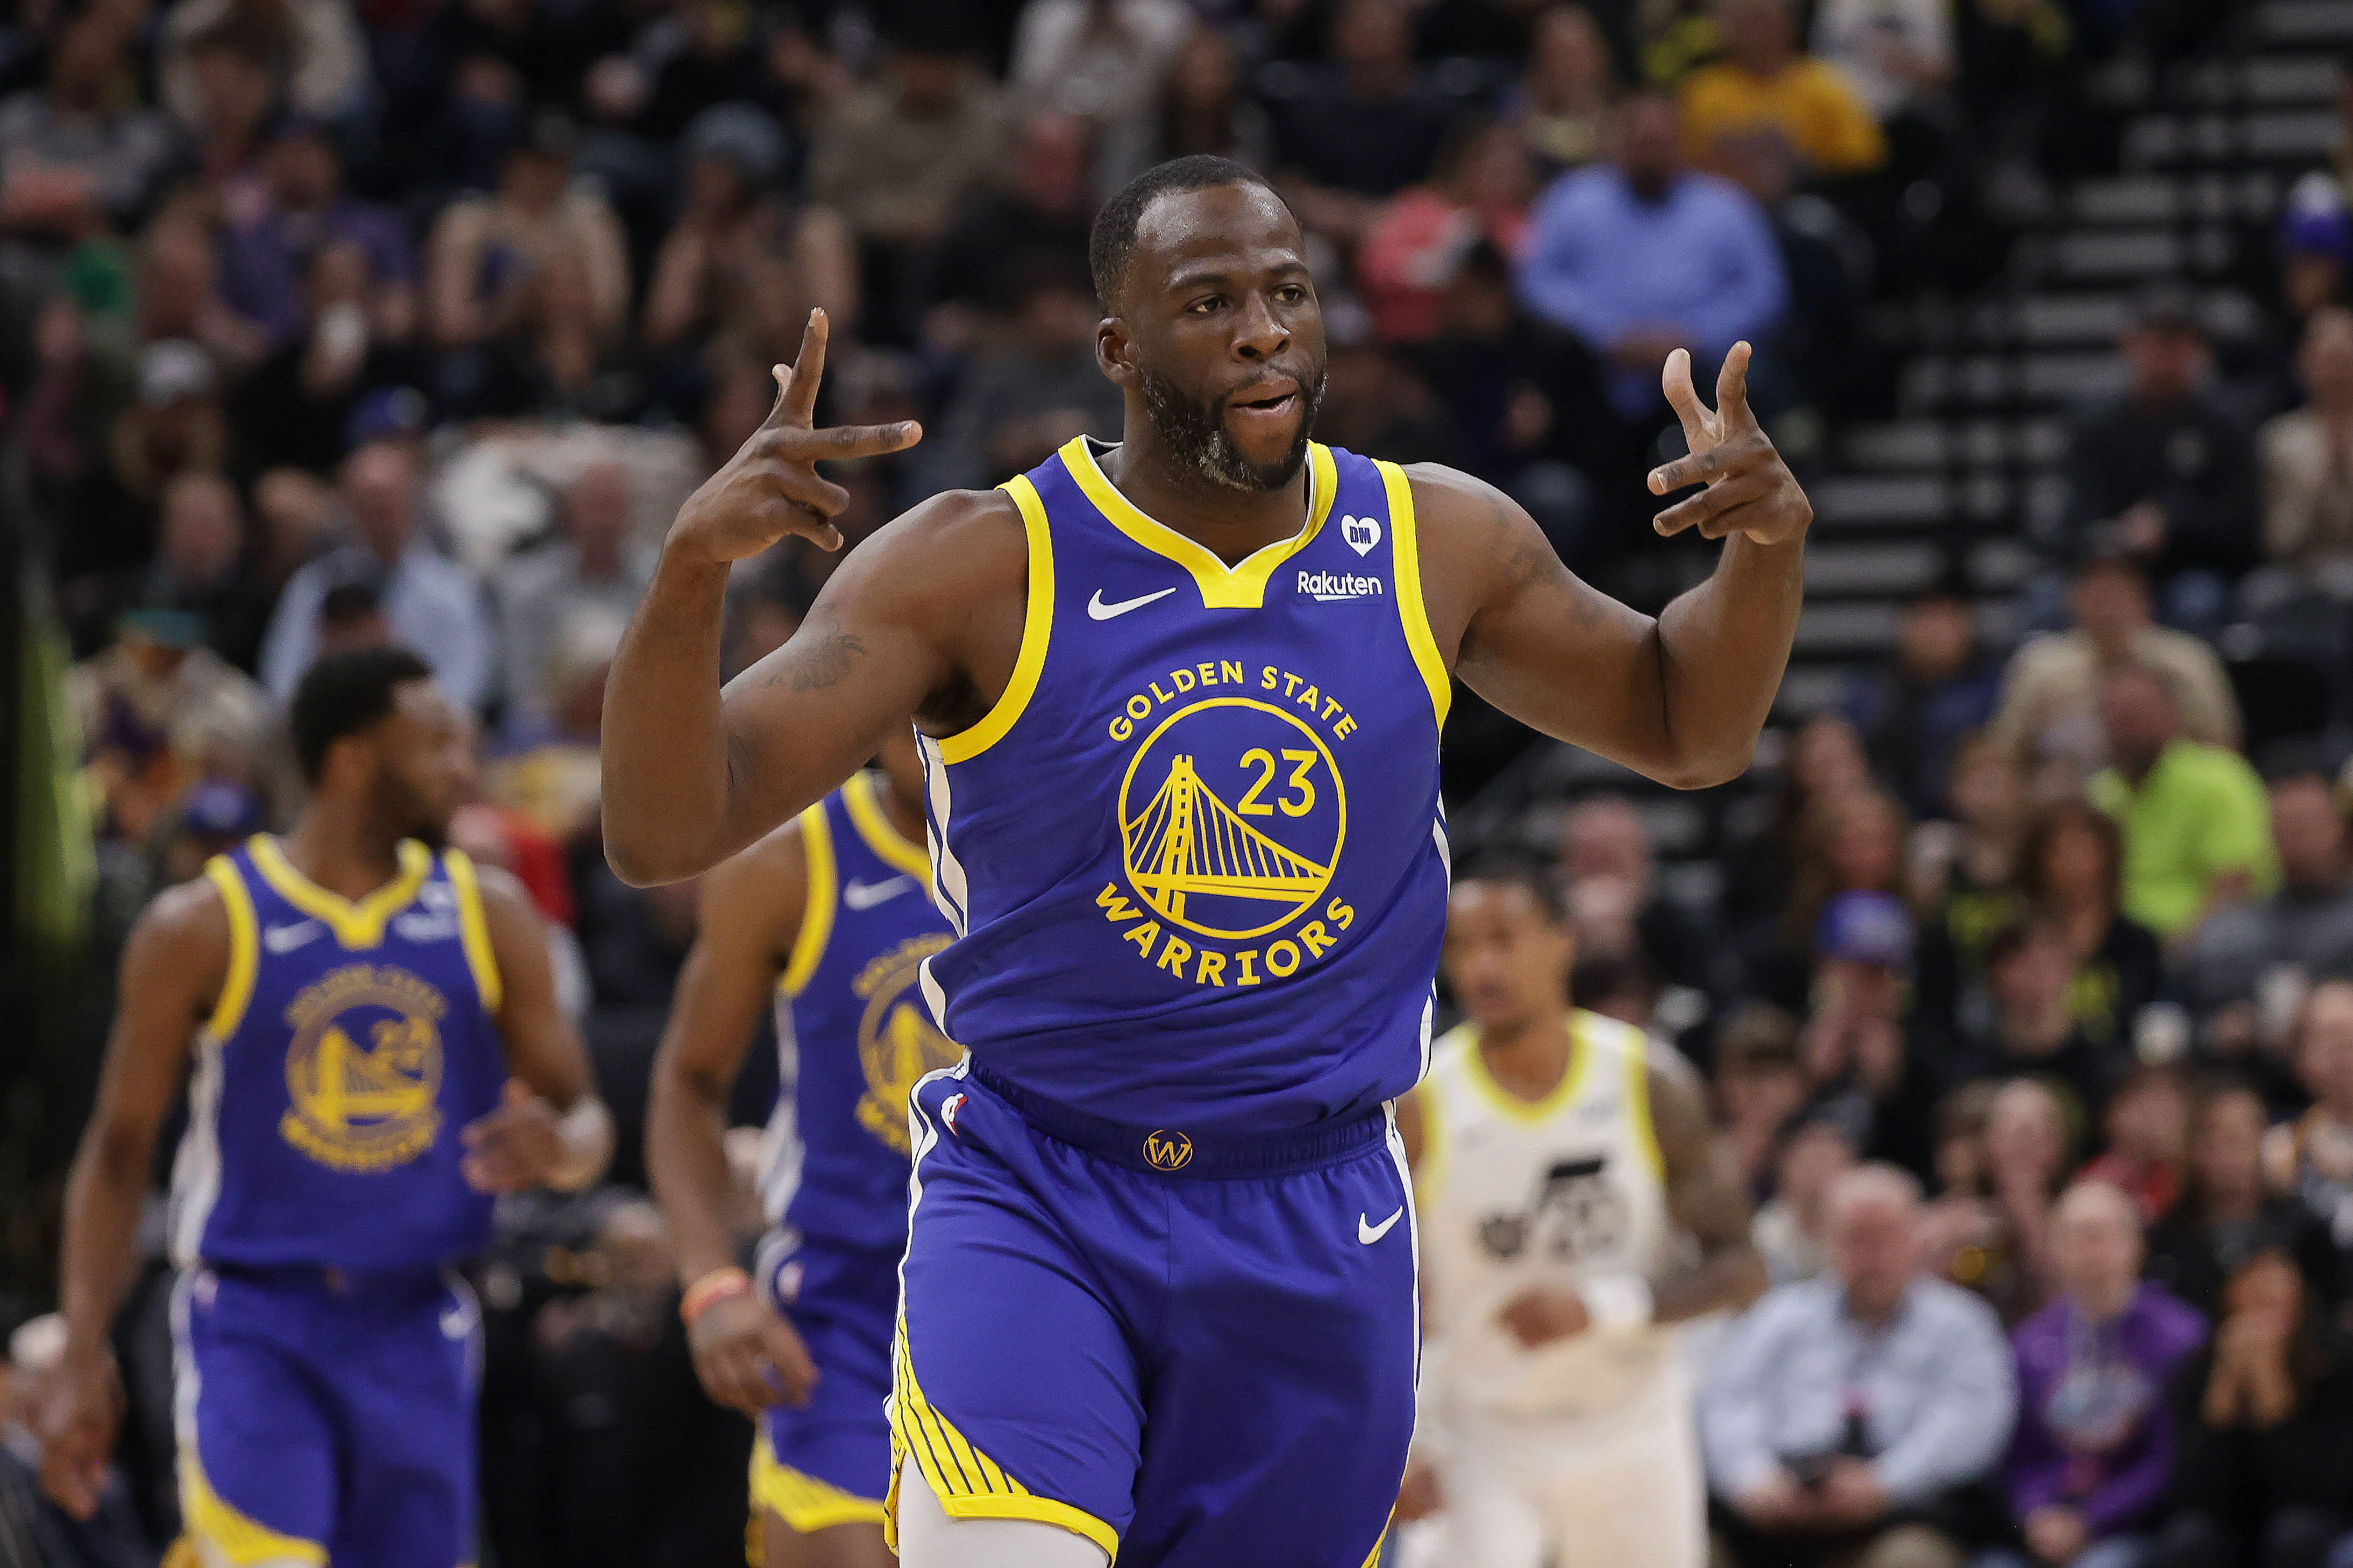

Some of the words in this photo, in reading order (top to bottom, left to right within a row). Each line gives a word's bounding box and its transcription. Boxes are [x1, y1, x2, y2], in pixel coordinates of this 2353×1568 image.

[1350, 526, 1372, 544] DM
[1297, 570, 1383, 596] Rakuten
[1109, 660, 1244, 742] GOLDEN
[1261, 665, 1359, 742] STATE
[1237, 748, 1318, 817] 23
[1095, 881, 1355, 988] WARRIORS
[1148, 1137, 1191, 1167] W
